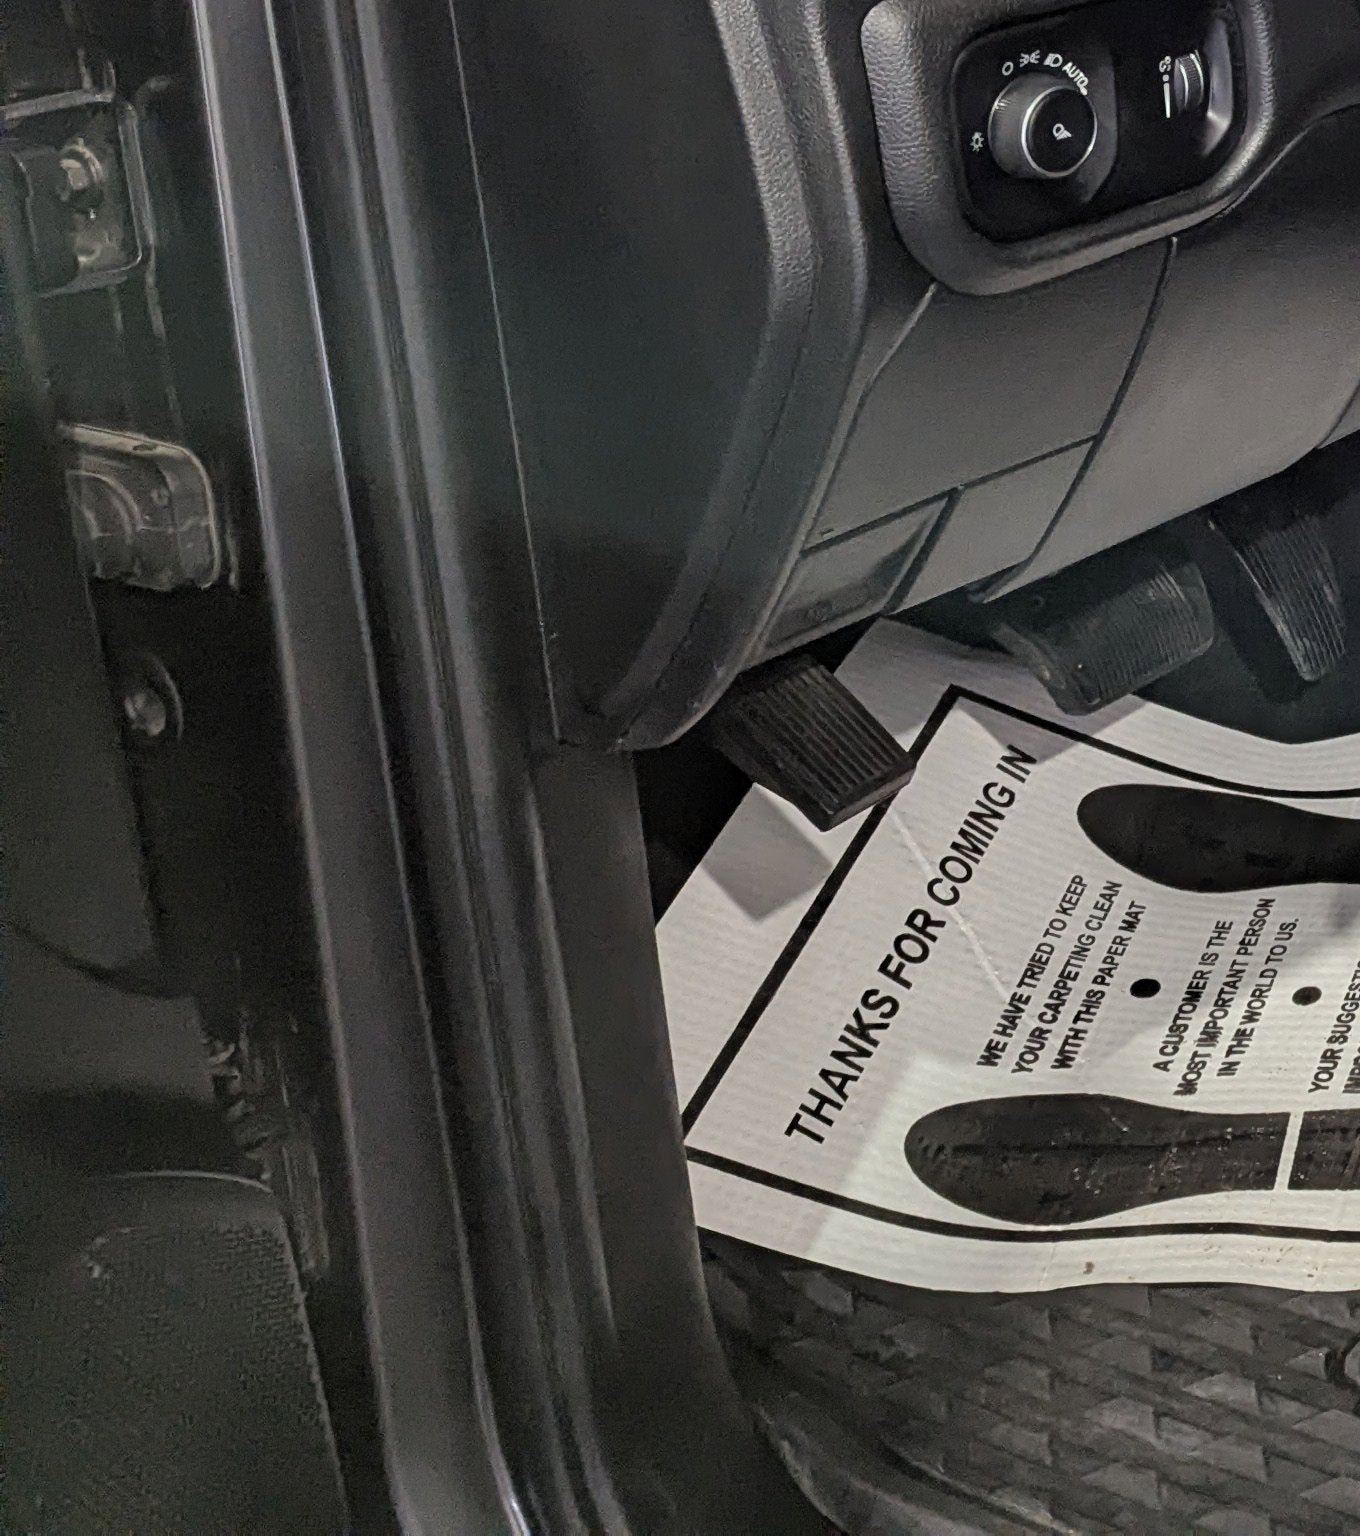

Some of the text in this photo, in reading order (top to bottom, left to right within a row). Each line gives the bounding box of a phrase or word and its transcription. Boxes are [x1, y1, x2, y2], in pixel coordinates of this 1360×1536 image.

[1062, 62, 1089, 88] AUTO
[784, 744, 1038, 1144] THANKS FOR COMING IN
[976, 874, 1088, 1067] WE HAVE TRIED TO KEEP
[1010, 880, 1123, 1074] YOUR CARPETING CLEAN
[1050, 900, 1147, 1070] WITH THIS PAPER MAT
[1152, 920, 1234, 1072] A CUSTOMER IS THE
[1173, 898, 1276, 1096] MOST IMPORTANT PERSON
[1216, 918, 1299, 1077] IN THE WORLD TO US.
[1308, 1047, 1344, 1094] YOUR
